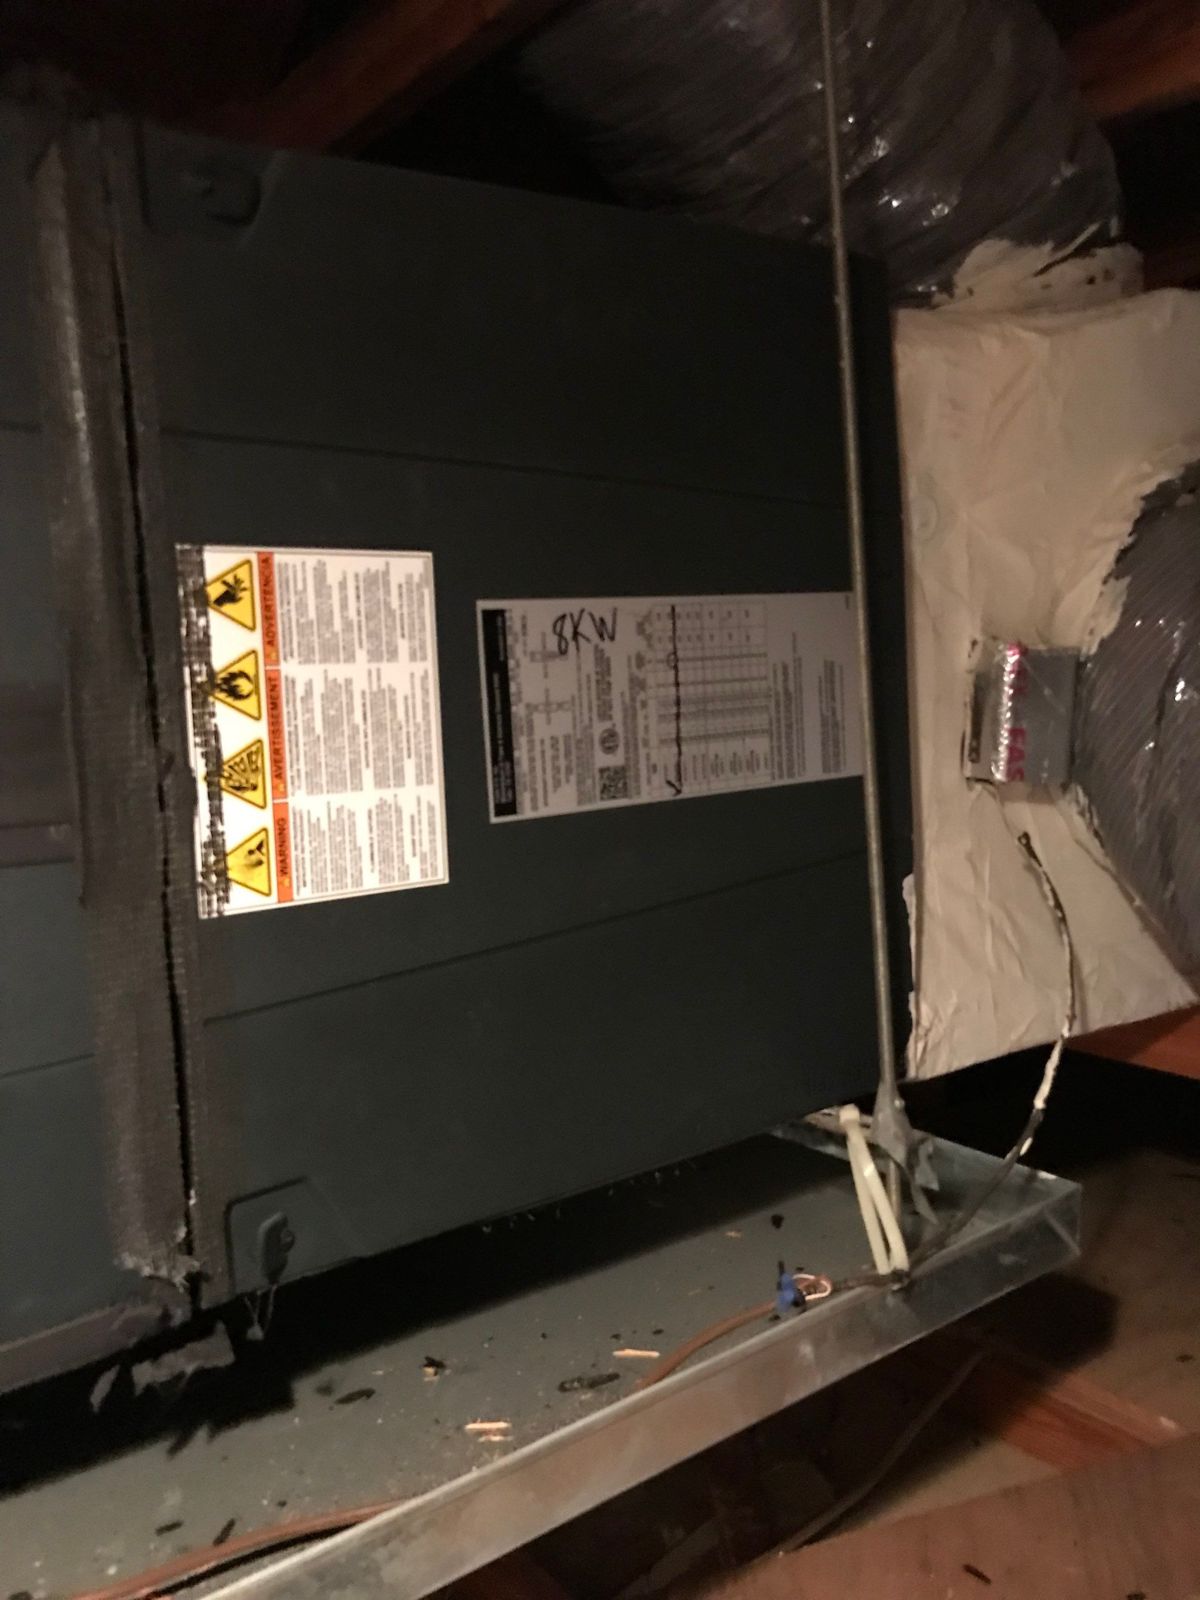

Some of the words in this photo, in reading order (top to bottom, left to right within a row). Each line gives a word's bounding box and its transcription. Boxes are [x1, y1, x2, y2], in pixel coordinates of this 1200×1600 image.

[260, 556, 277, 647] ADVERTENCIA
[552, 608, 618, 655] 8KW
[267, 677, 284, 780] AVERTISSEMENT
[276, 817, 289, 876] WARNING
